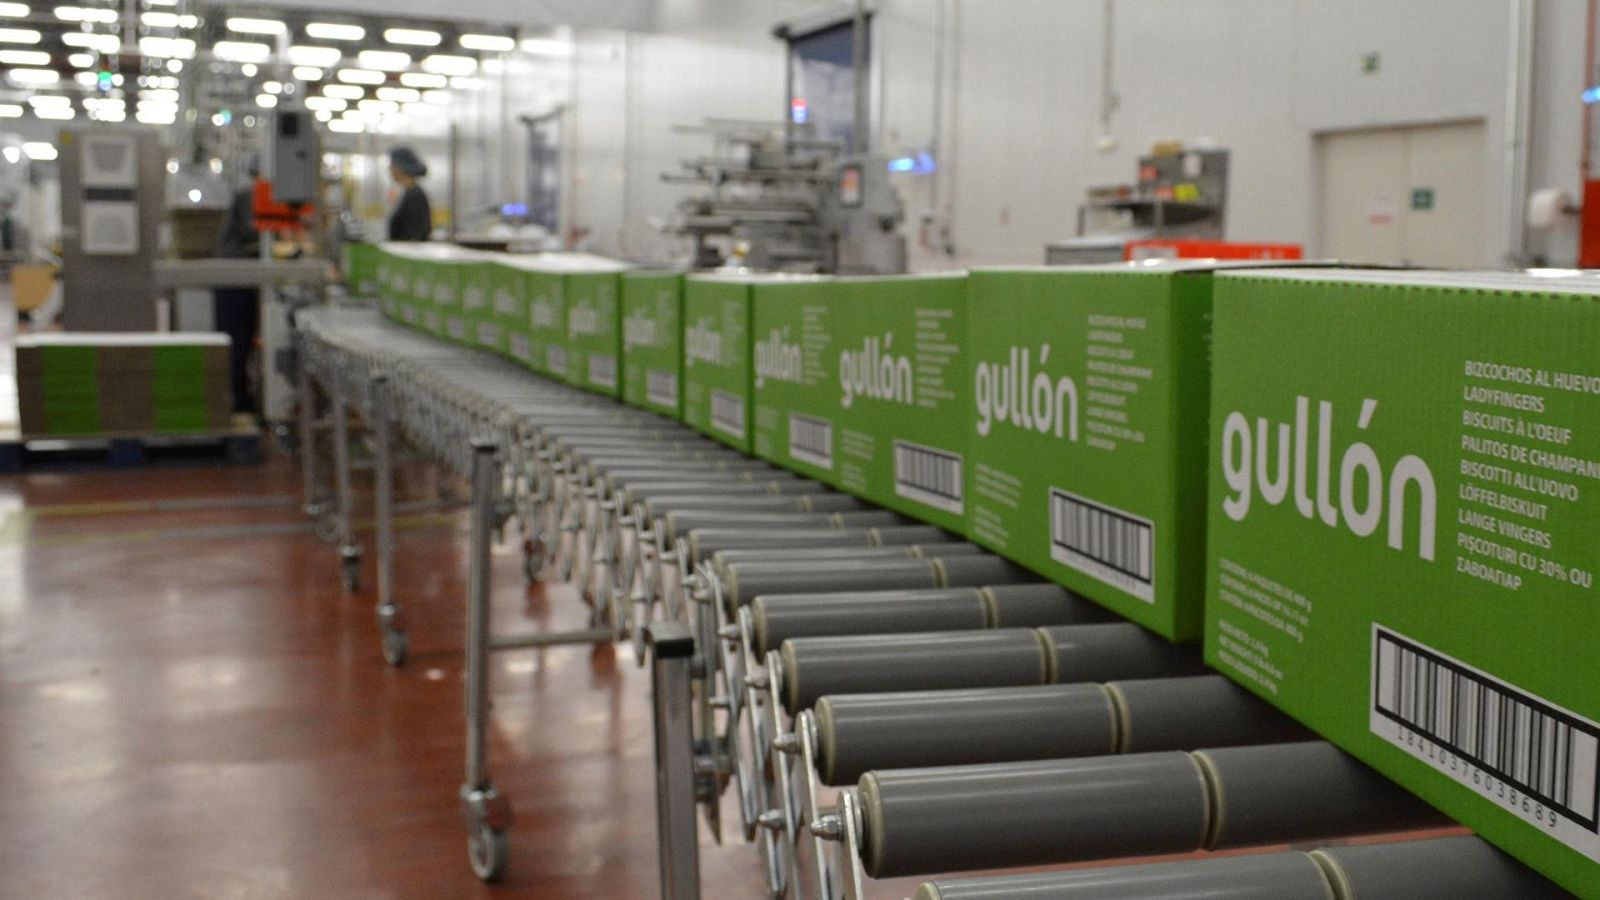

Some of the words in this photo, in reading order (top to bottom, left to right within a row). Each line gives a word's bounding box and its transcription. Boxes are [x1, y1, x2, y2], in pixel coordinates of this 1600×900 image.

[839, 330, 912, 408] gullón
[1464, 360, 1532, 384] BIZCOCHOS
[1534, 369, 1551, 387] AL
[1553, 372, 1600, 394] HUEVO
[975, 343, 1079, 442] gullón
[1463, 385, 1545, 413] LADYFINGERS
[1462, 410, 1514, 433] BISCUITS
[1527, 422, 1572, 445] L'OEUF
[1461, 434, 1509, 458] PALITOS
[1511, 445, 1528, 463] DE
[1222, 394, 1437, 562] gullón
[1460, 459, 1512, 486] BISCOTTI
[1513, 472, 1579, 502] ALL'UOVO
[1459, 483, 1548, 522] LÖFFELBISKUIT
[1458, 508, 1496, 532] LANGE
[1498, 519, 1552, 549] VINGERS
[1519, 552, 1537, 571] CU
[1538, 559, 1567, 581] 30%
[1569, 568, 1592, 588] OU
